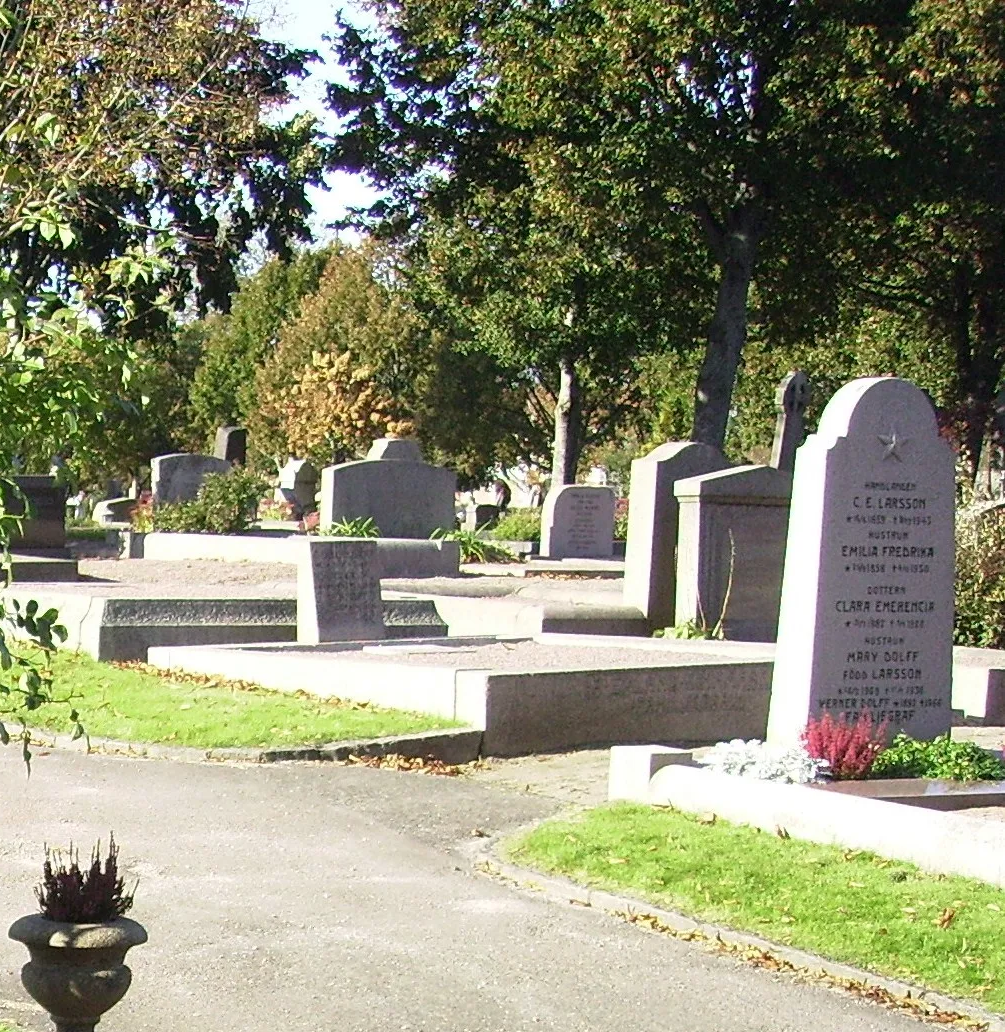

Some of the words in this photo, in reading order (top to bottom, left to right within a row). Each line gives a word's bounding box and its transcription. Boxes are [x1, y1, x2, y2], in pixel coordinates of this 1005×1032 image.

[879, 497, 926, 510] LARSSON
[841, 545, 878, 557] EMILIA
[882, 546, 935, 558] FREDRIKA
[835, 600, 871, 613] CLARA
[874, 600, 935, 613] EMERENCIA
[847, 651, 878, 663] MARY
[883, 651, 920, 663] DOLFF
[871, 668, 922, 680] LARSSON
[845, 710, 915, 724] FALJEGRAF
